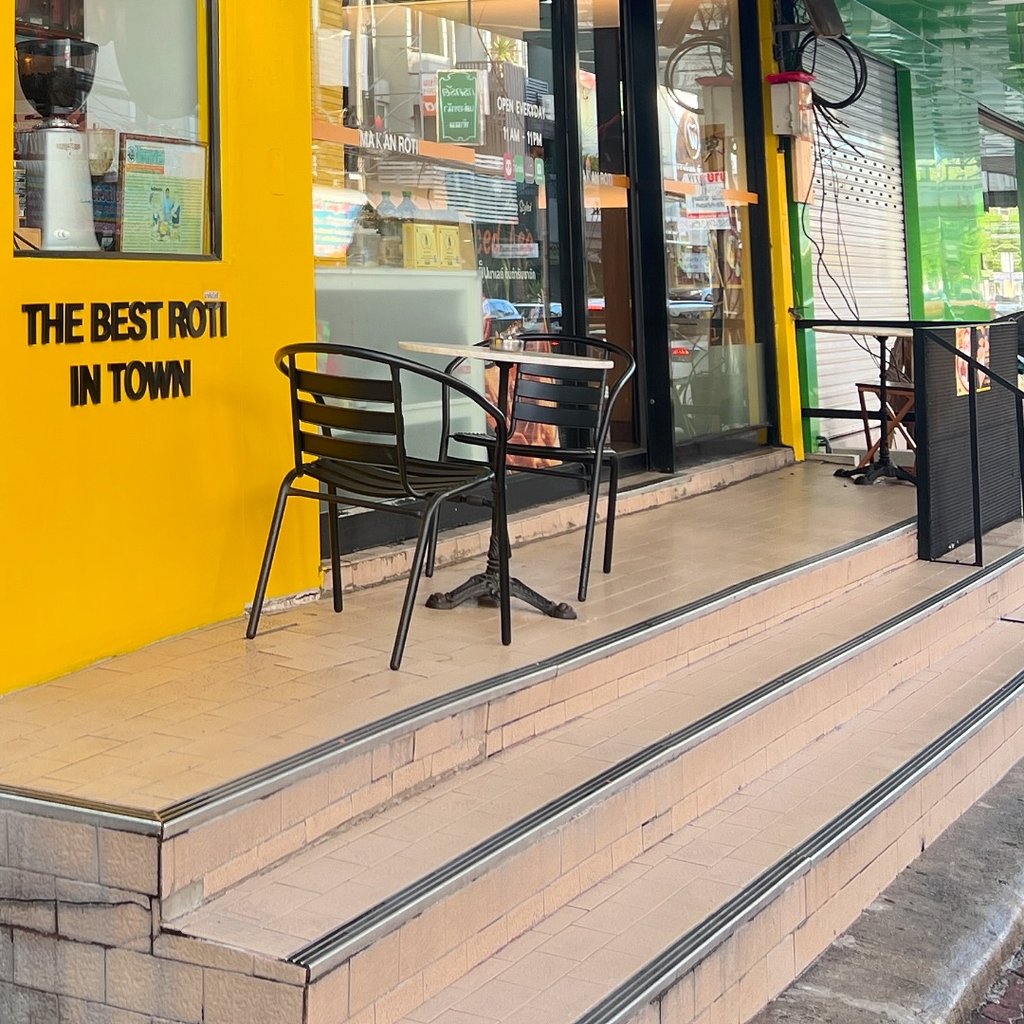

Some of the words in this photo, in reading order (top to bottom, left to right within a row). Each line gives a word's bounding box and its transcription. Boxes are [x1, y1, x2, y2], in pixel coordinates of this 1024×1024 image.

[497, 96, 513, 113] OPEN
[516, 100, 546, 120] EVERYDAY
[398, 136, 418, 155] ROTI
[21, 303, 85, 346] THE
[90, 301, 164, 342] BEST
[168, 299, 228, 338] ROTI
[70, 364, 101, 407] IN
[107, 359, 192, 403] TOWN
